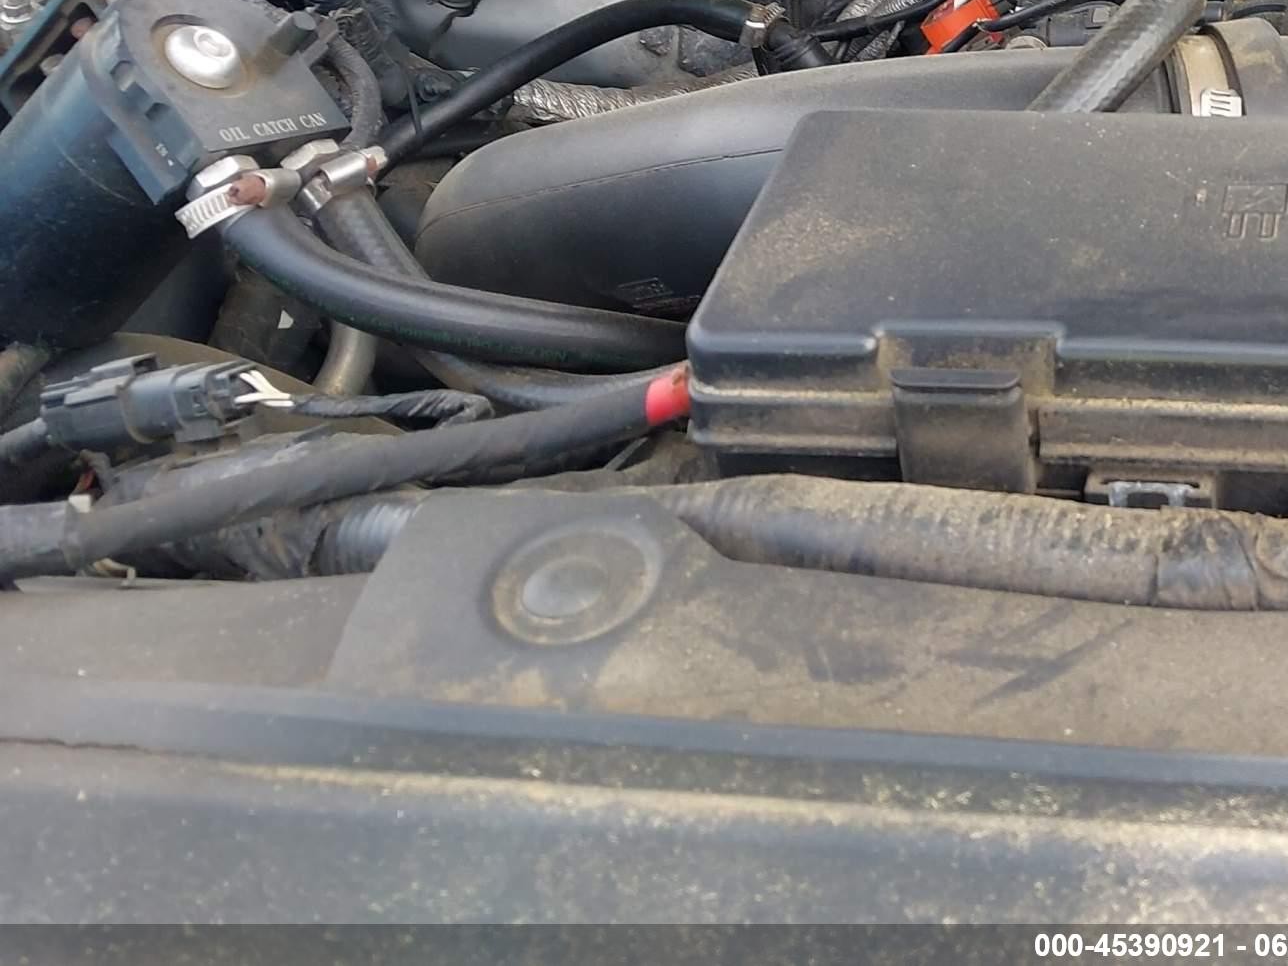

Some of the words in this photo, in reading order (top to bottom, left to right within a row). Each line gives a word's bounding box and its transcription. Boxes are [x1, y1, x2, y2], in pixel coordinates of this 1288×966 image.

[219, 126, 250, 142] OIL
[252, 118, 298, 136] CATCH
[299, 112, 327, 128] CAN
